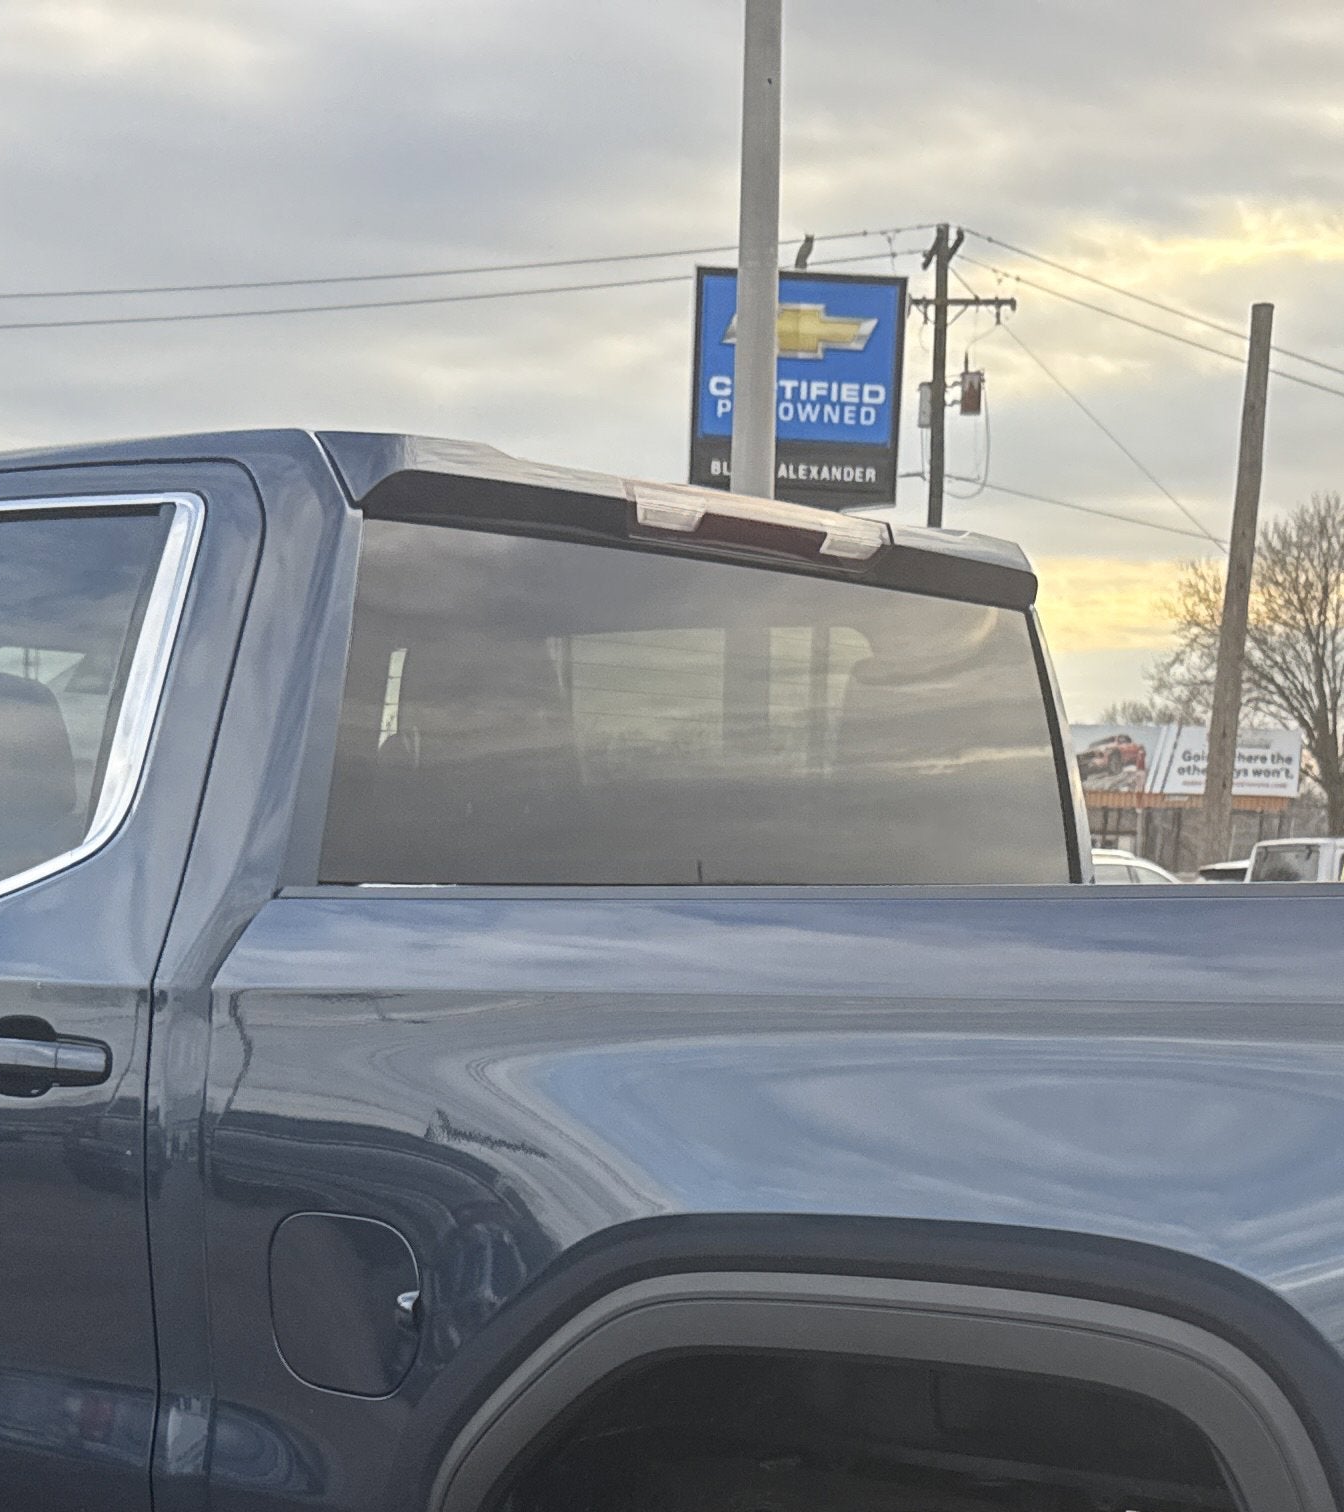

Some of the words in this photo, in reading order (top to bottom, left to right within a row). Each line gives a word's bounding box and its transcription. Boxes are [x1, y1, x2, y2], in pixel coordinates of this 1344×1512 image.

[708, 376, 887, 405] CTIFIED
[777, 463, 877, 484] ALEXANDER
[1270, 751, 1293, 766] the
